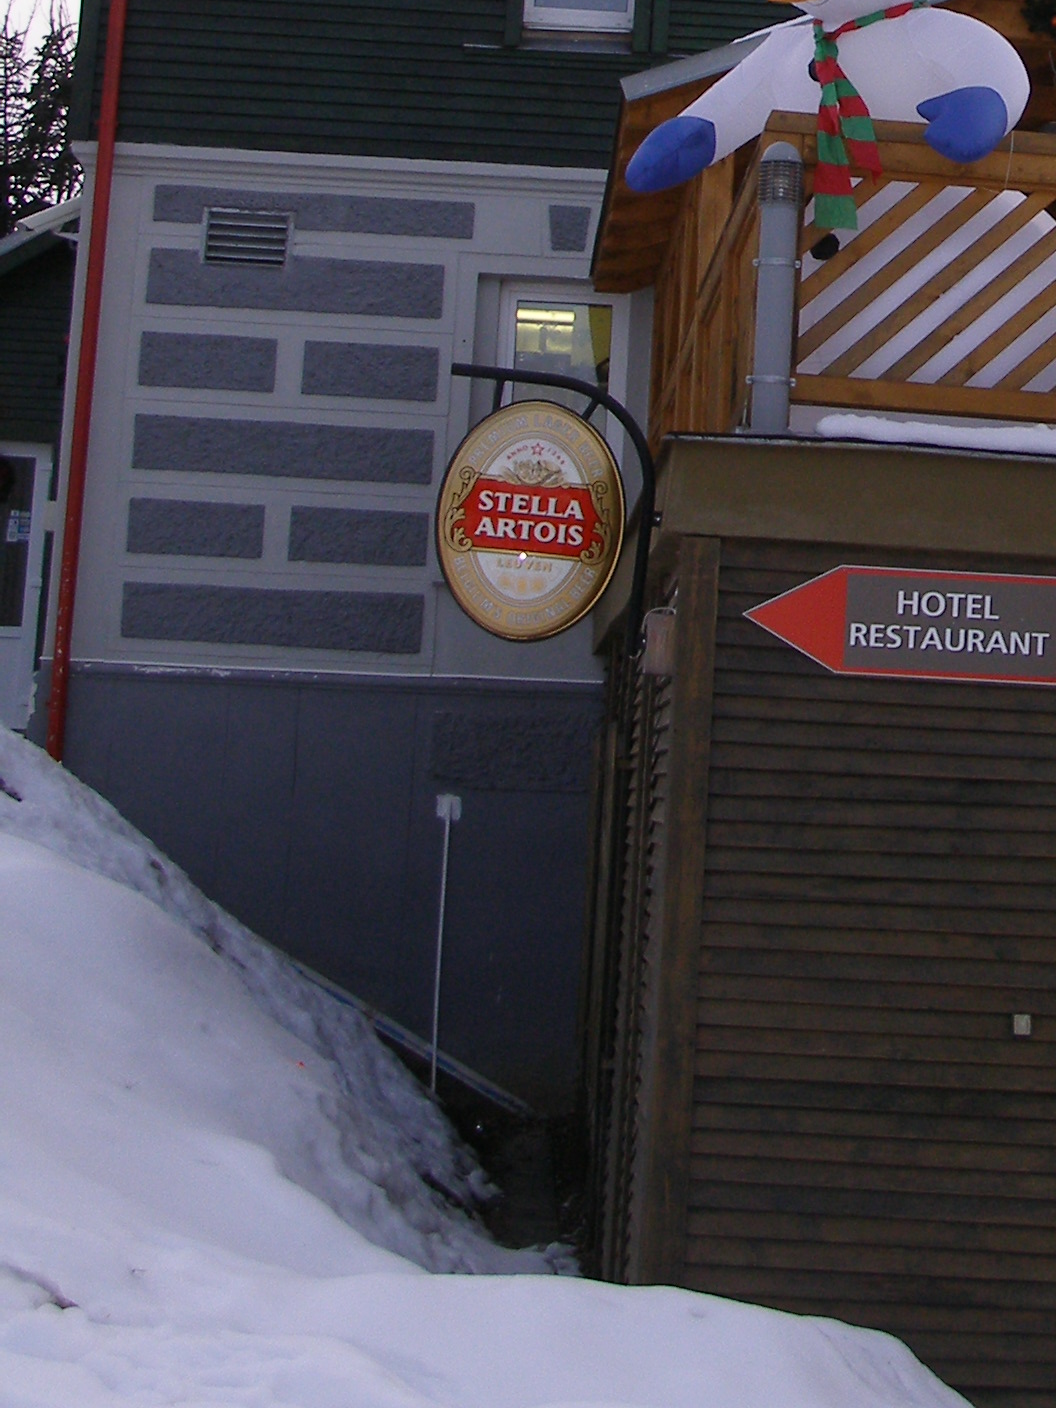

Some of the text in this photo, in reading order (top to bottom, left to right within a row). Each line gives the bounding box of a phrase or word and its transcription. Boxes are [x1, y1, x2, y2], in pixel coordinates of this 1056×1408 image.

[478, 489, 585, 520] STELLA
[474, 517, 584, 546] ARTOIS
[897, 590, 999, 620] HOTEL
[849, 622, 1050, 656] RESTAURANT
